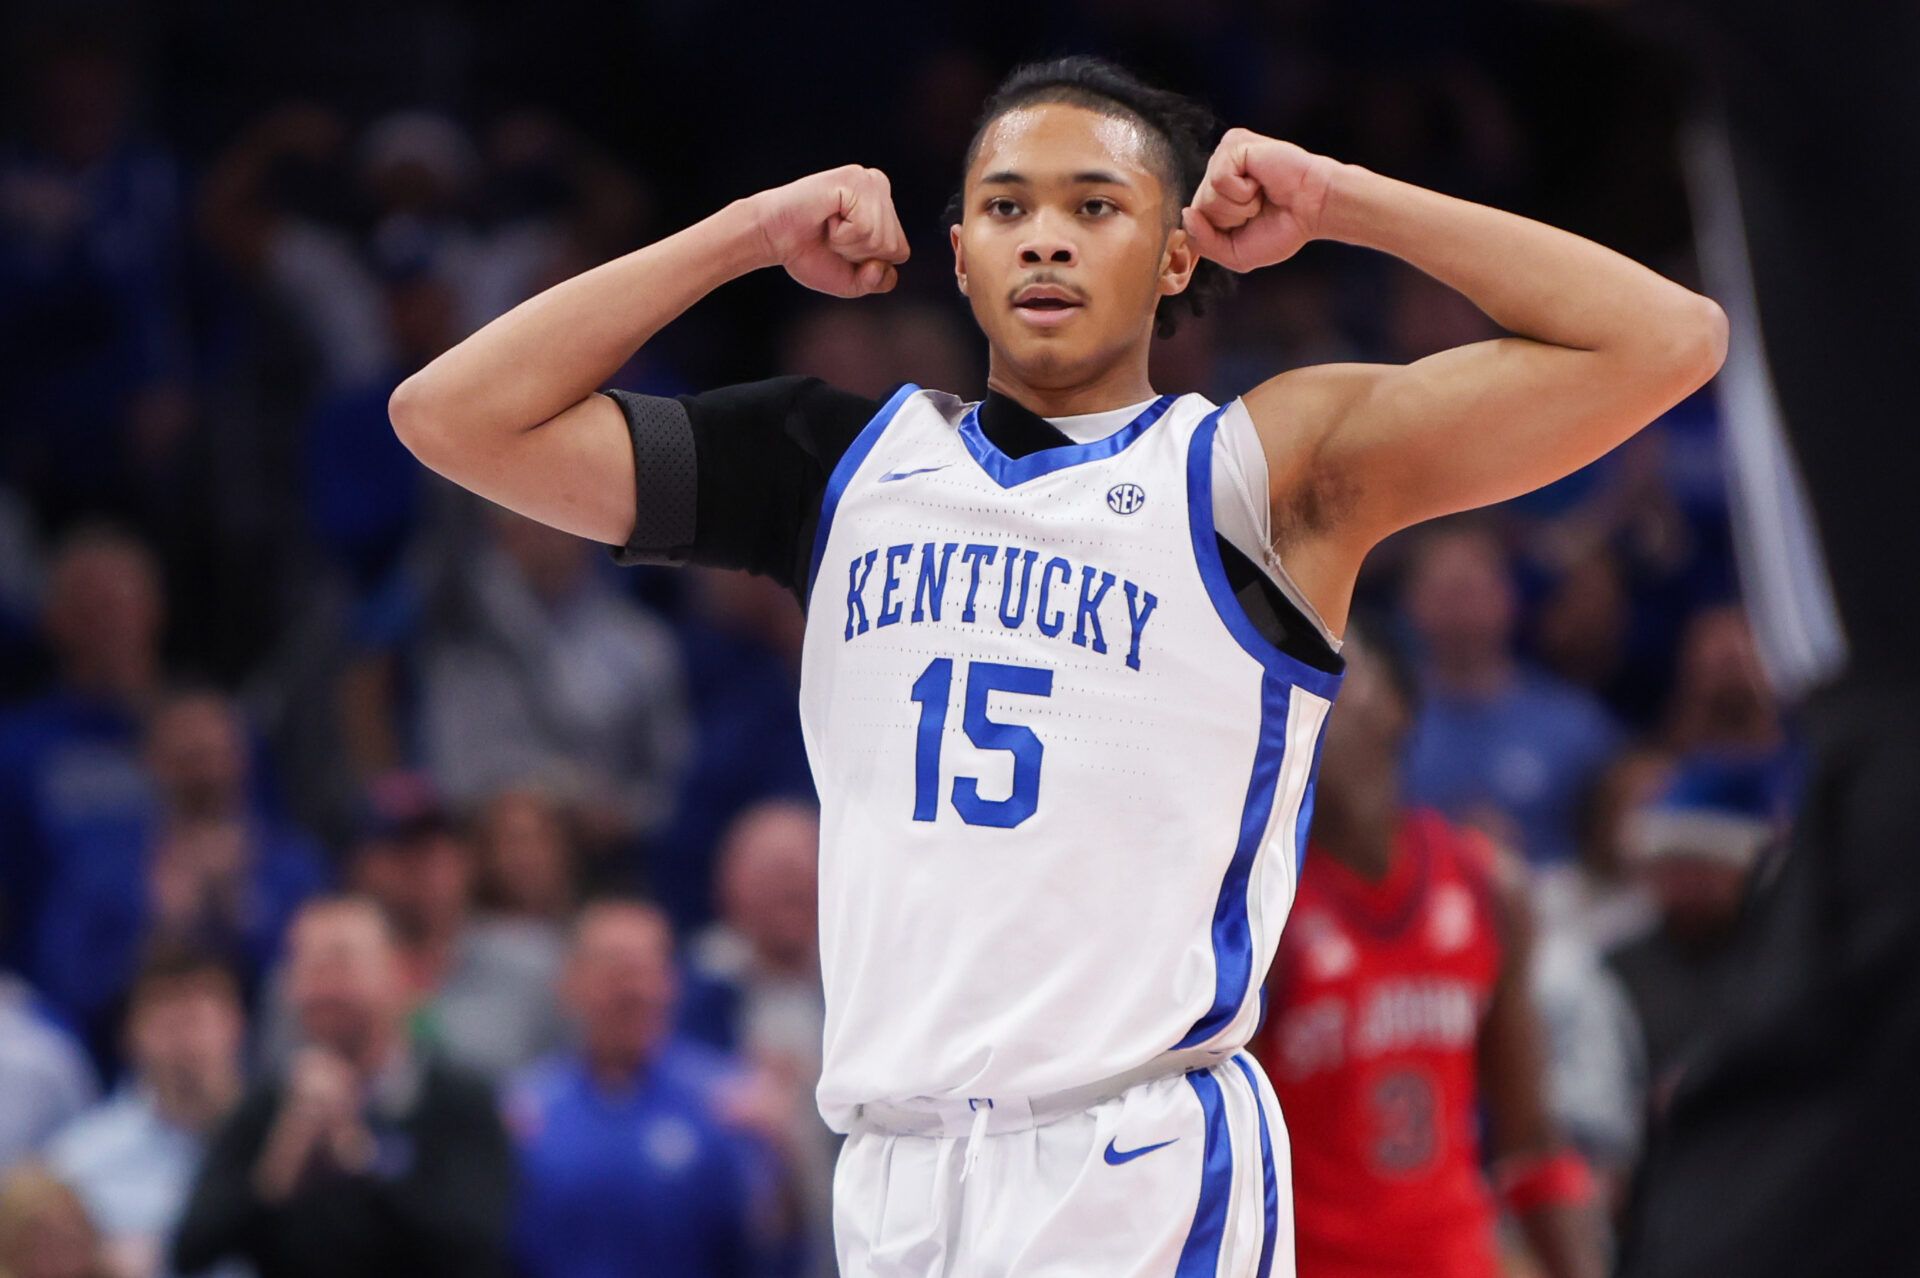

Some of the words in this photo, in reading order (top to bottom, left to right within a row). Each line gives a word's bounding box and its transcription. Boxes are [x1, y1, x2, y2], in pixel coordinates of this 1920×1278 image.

[1107, 484, 1145, 515] SEC
[844, 542, 1158, 672] KENTUCKY
[910, 657, 1054, 829] 15
